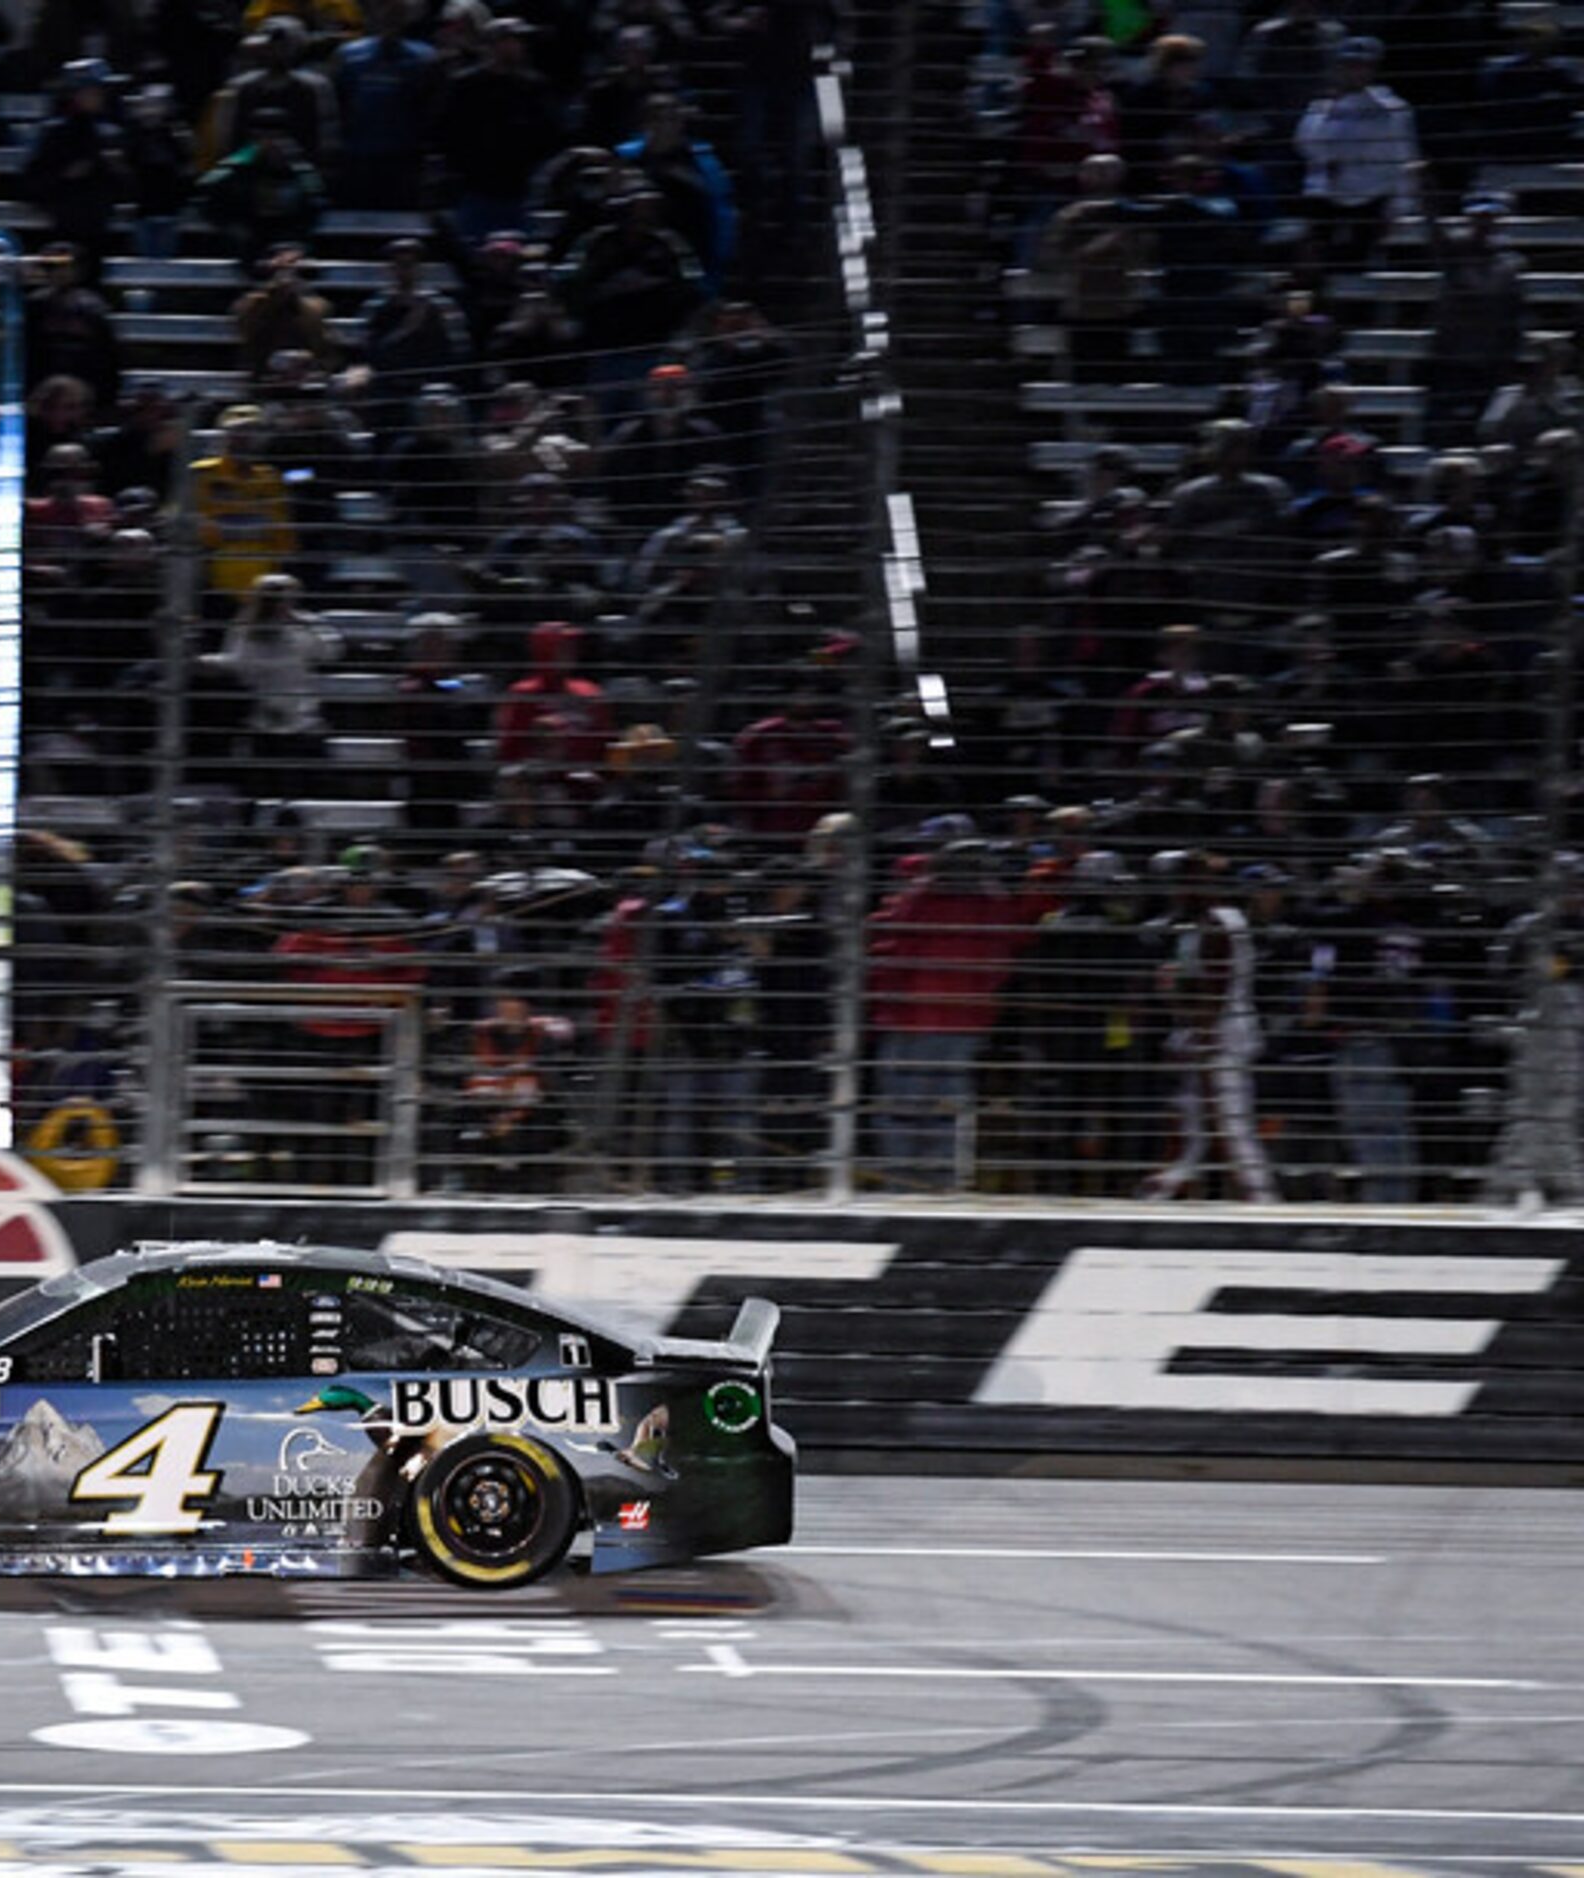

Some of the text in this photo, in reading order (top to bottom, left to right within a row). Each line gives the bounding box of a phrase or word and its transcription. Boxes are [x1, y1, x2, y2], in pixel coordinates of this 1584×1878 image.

[393, 1376, 619, 1433] BUSCH
[68, 1400, 227, 1537] 4
[273, 1473, 356, 1498] DUCKS
[246, 1496, 384, 1523] UNLIMITED
